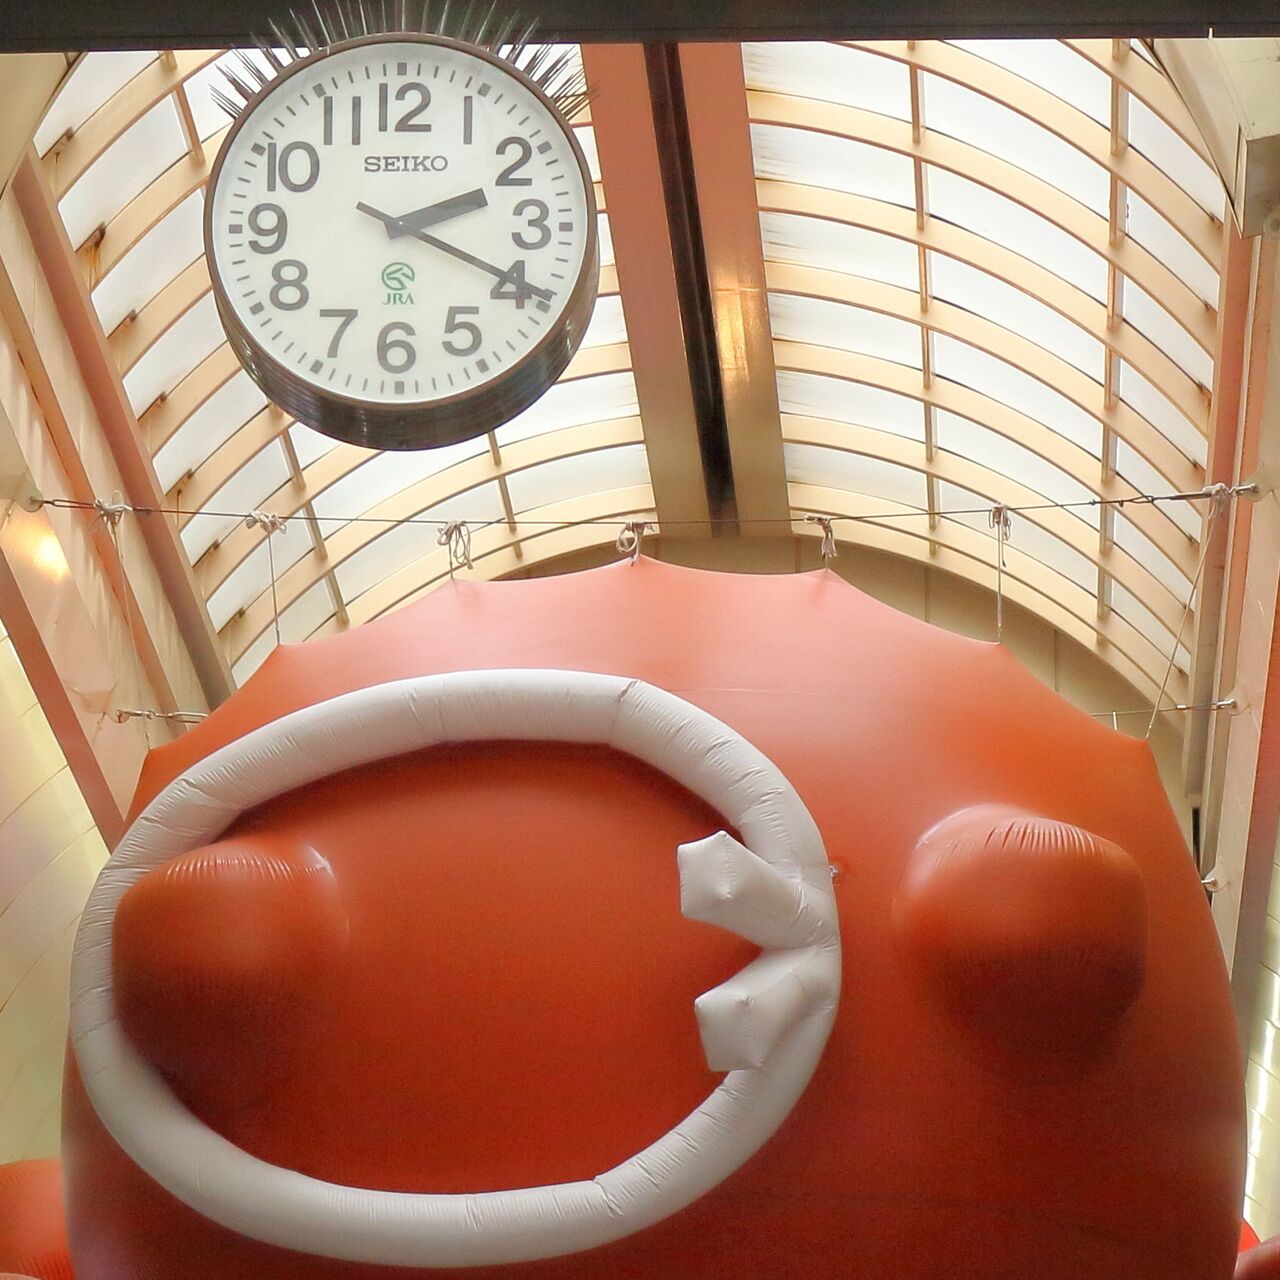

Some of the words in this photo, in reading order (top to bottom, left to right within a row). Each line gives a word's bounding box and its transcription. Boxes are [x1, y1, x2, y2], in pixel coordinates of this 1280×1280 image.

[323, 96, 362, 145] 11
[378, 82, 432, 132] 12
[463, 95, 473, 145] 1
[267, 141, 320, 192] 10
[364, 156, 448, 172] SEIKO
[495, 137, 533, 186] 2
[248, 203, 287, 255] 9
[511, 198, 552, 250] 3
[269, 260, 310, 311] 8
[382, 293, 414, 305] JRA
[490, 260, 532, 309] 4
[320, 309, 358, 359] 7
[376, 321, 416, 374] 6
[442, 306, 482, 357] 5
